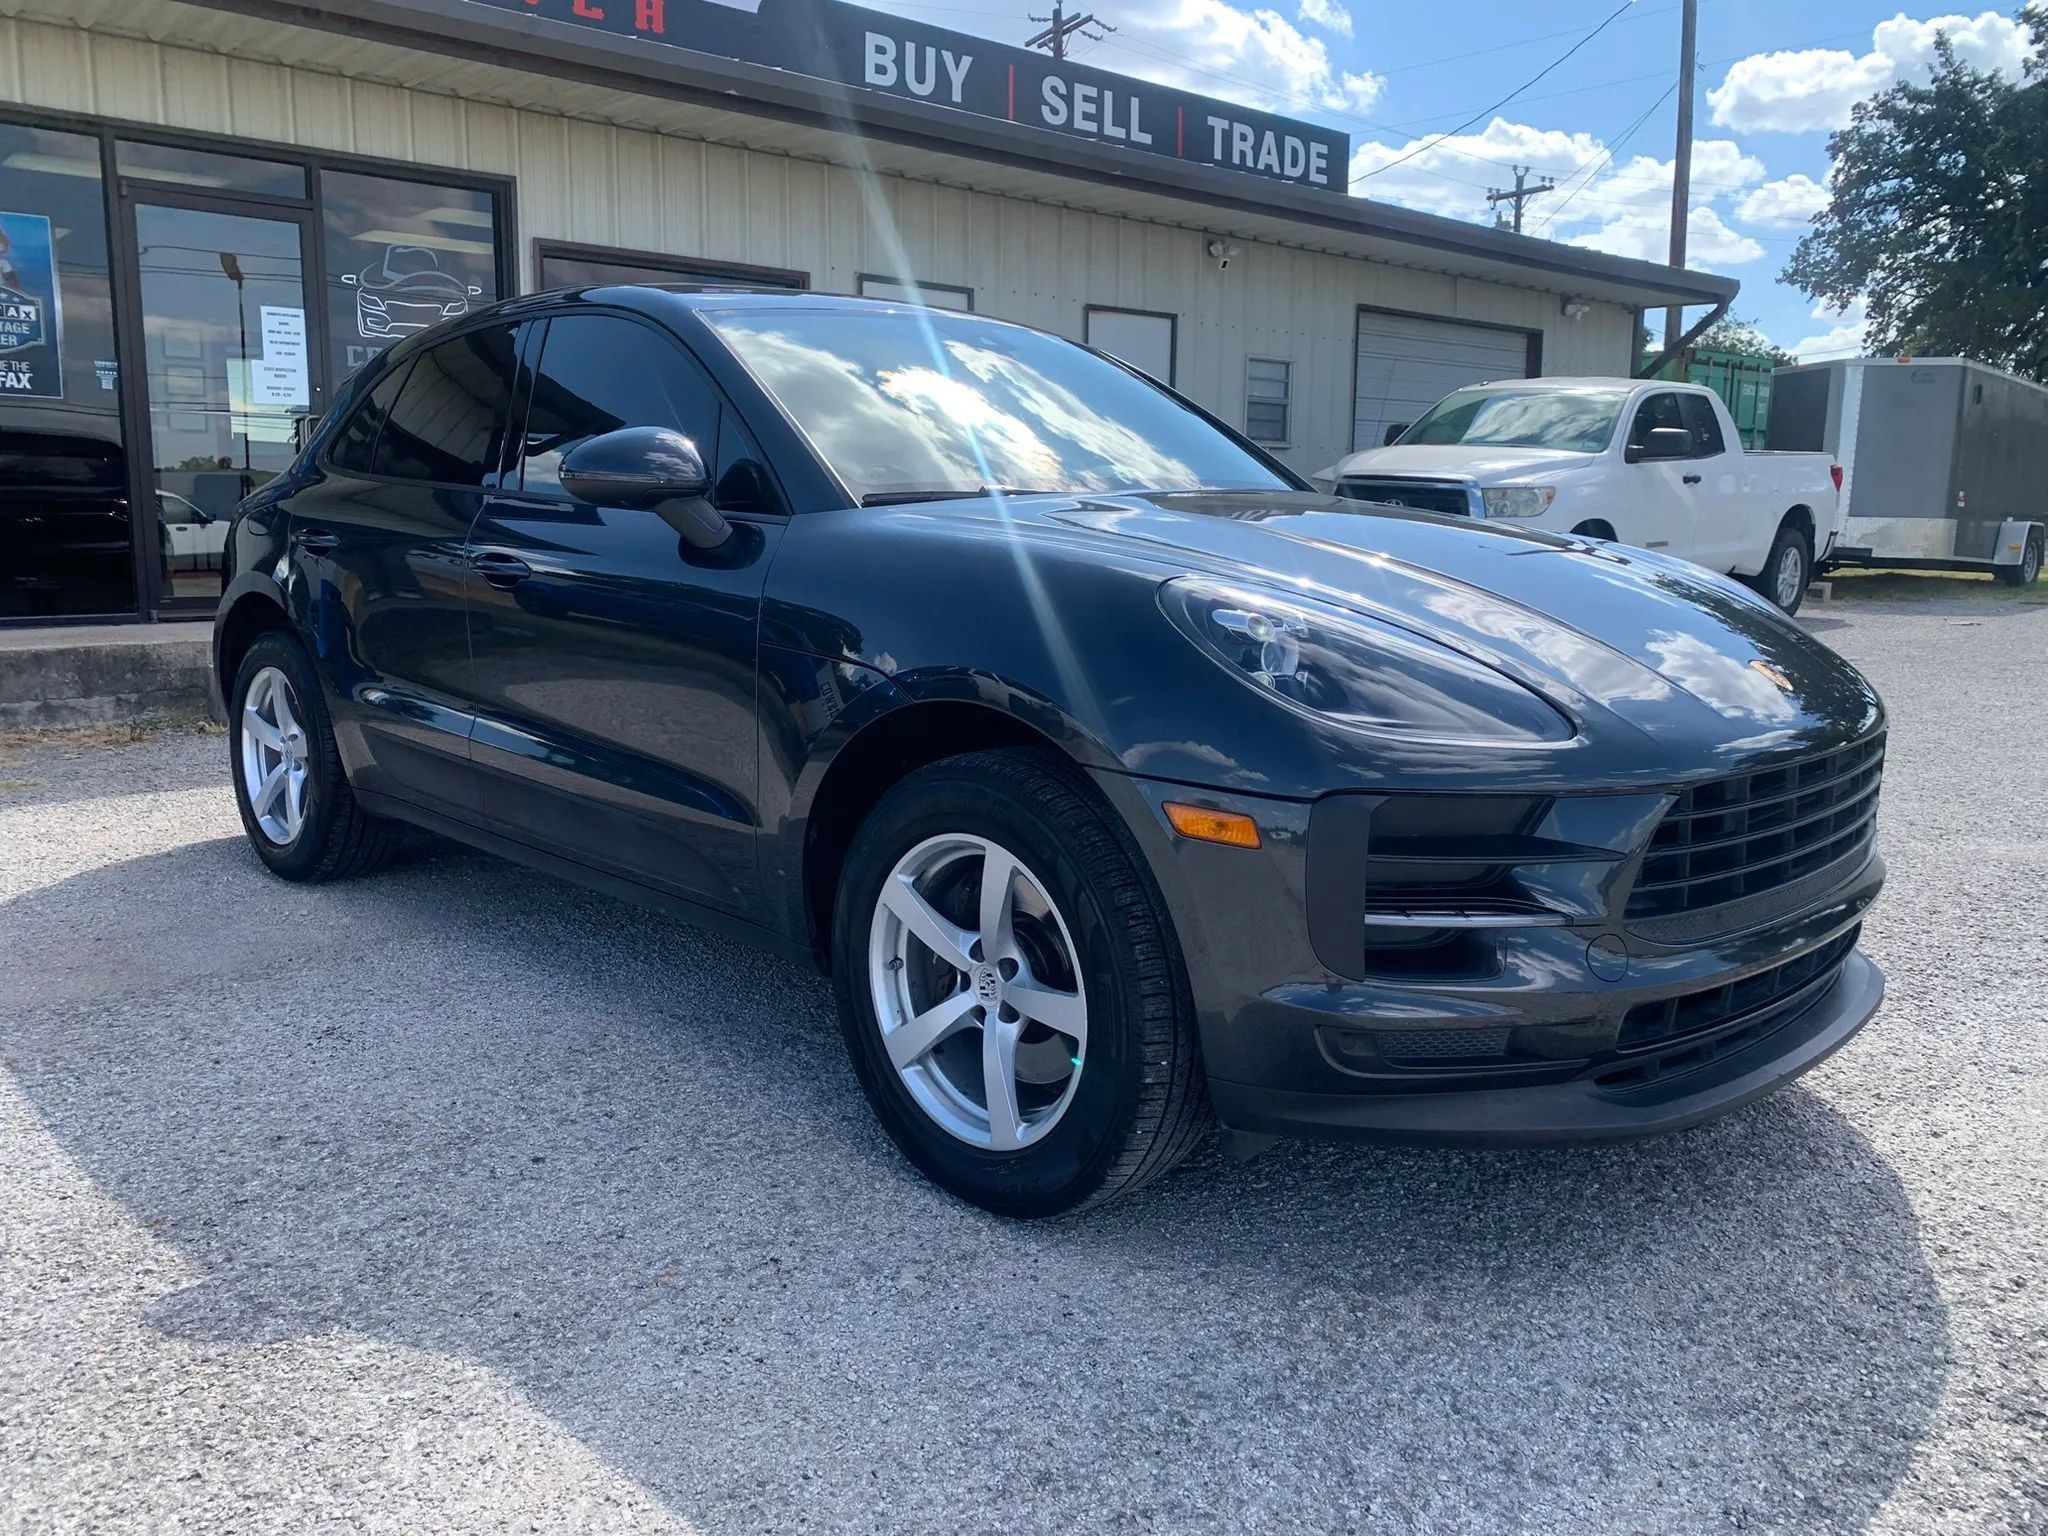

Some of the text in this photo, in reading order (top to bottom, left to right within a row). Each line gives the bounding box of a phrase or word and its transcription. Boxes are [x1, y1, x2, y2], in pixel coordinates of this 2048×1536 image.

[864, 31, 1329, 184] BUY SELL TRADE
[0, 305, 33, 320] AX
[10, 360, 31, 373] THE
